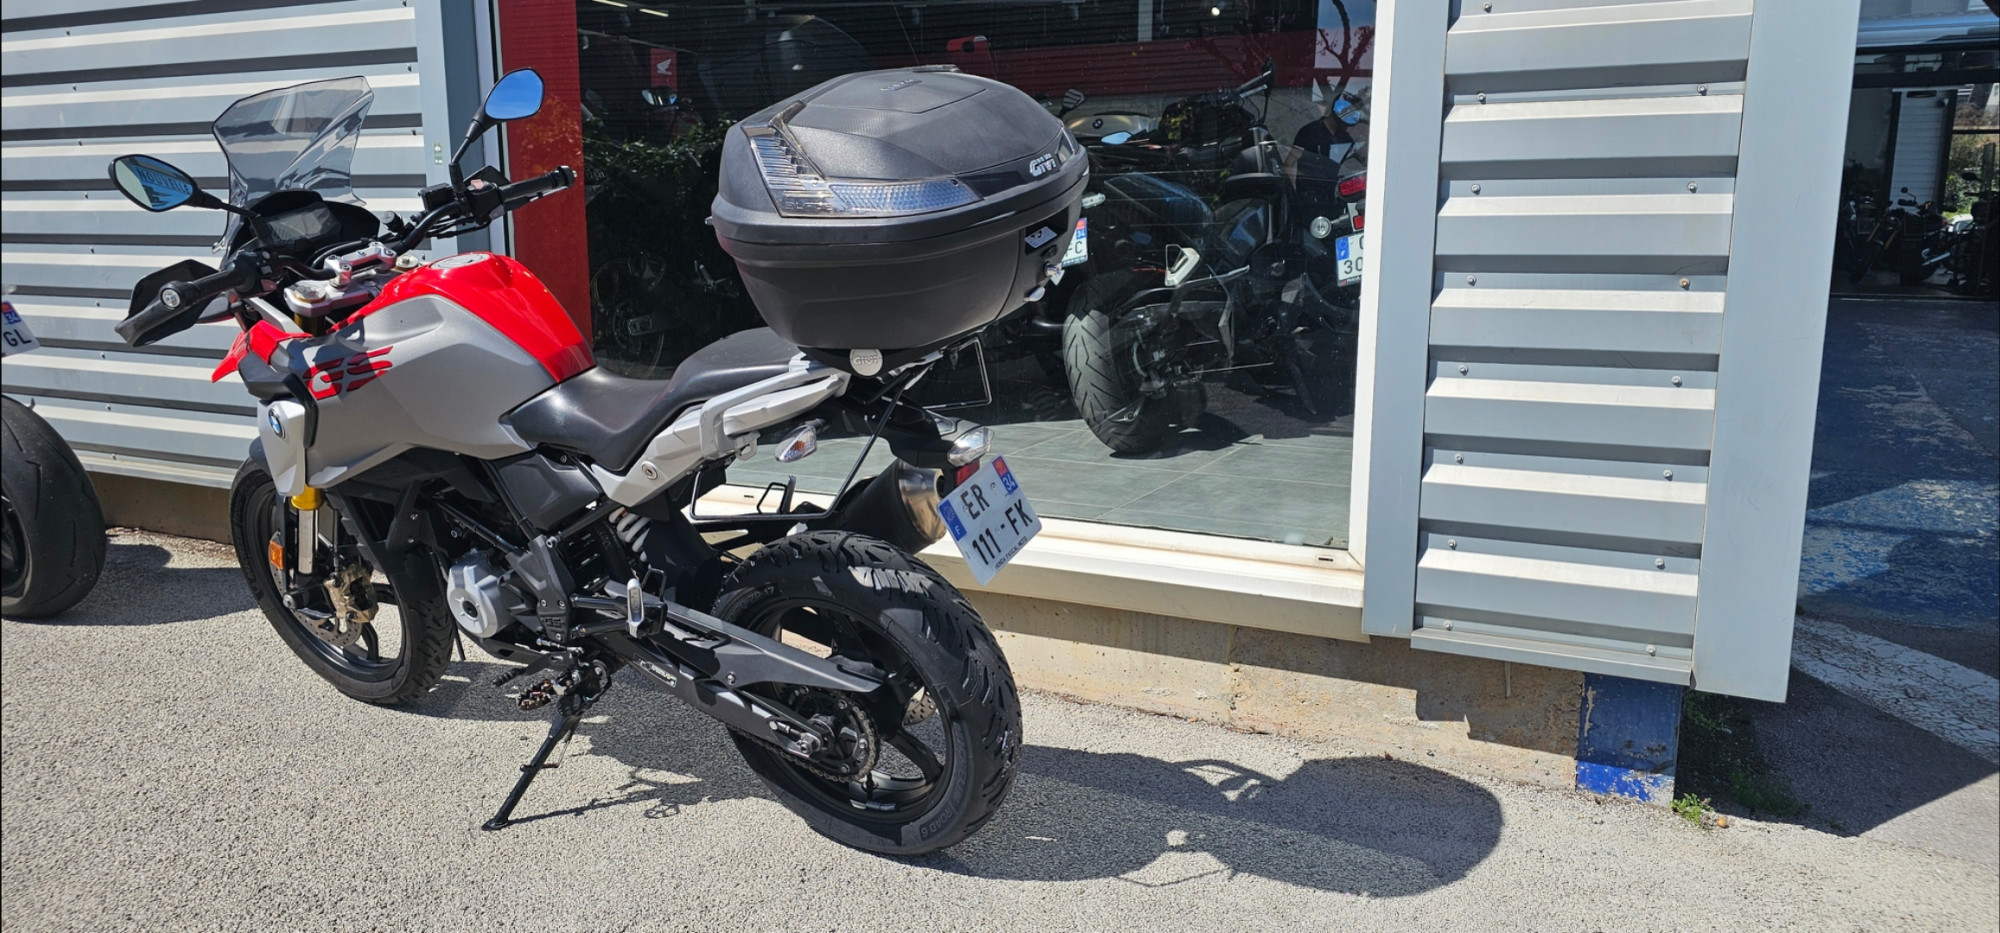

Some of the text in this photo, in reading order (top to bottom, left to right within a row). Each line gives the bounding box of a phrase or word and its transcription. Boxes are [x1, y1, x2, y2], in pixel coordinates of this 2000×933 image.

[2, 329, 32, 347] GL
[302, 345, 394, 401] GS
[1002, 474, 1017, 491] 34
[960, 483, 990, 520] ER
[972, 527, 1002, 565] 111
[1004, 498, 1033, 536] FK
[920, 826, 929, 838] 6
[929, 806, 953, 833] ROAD
